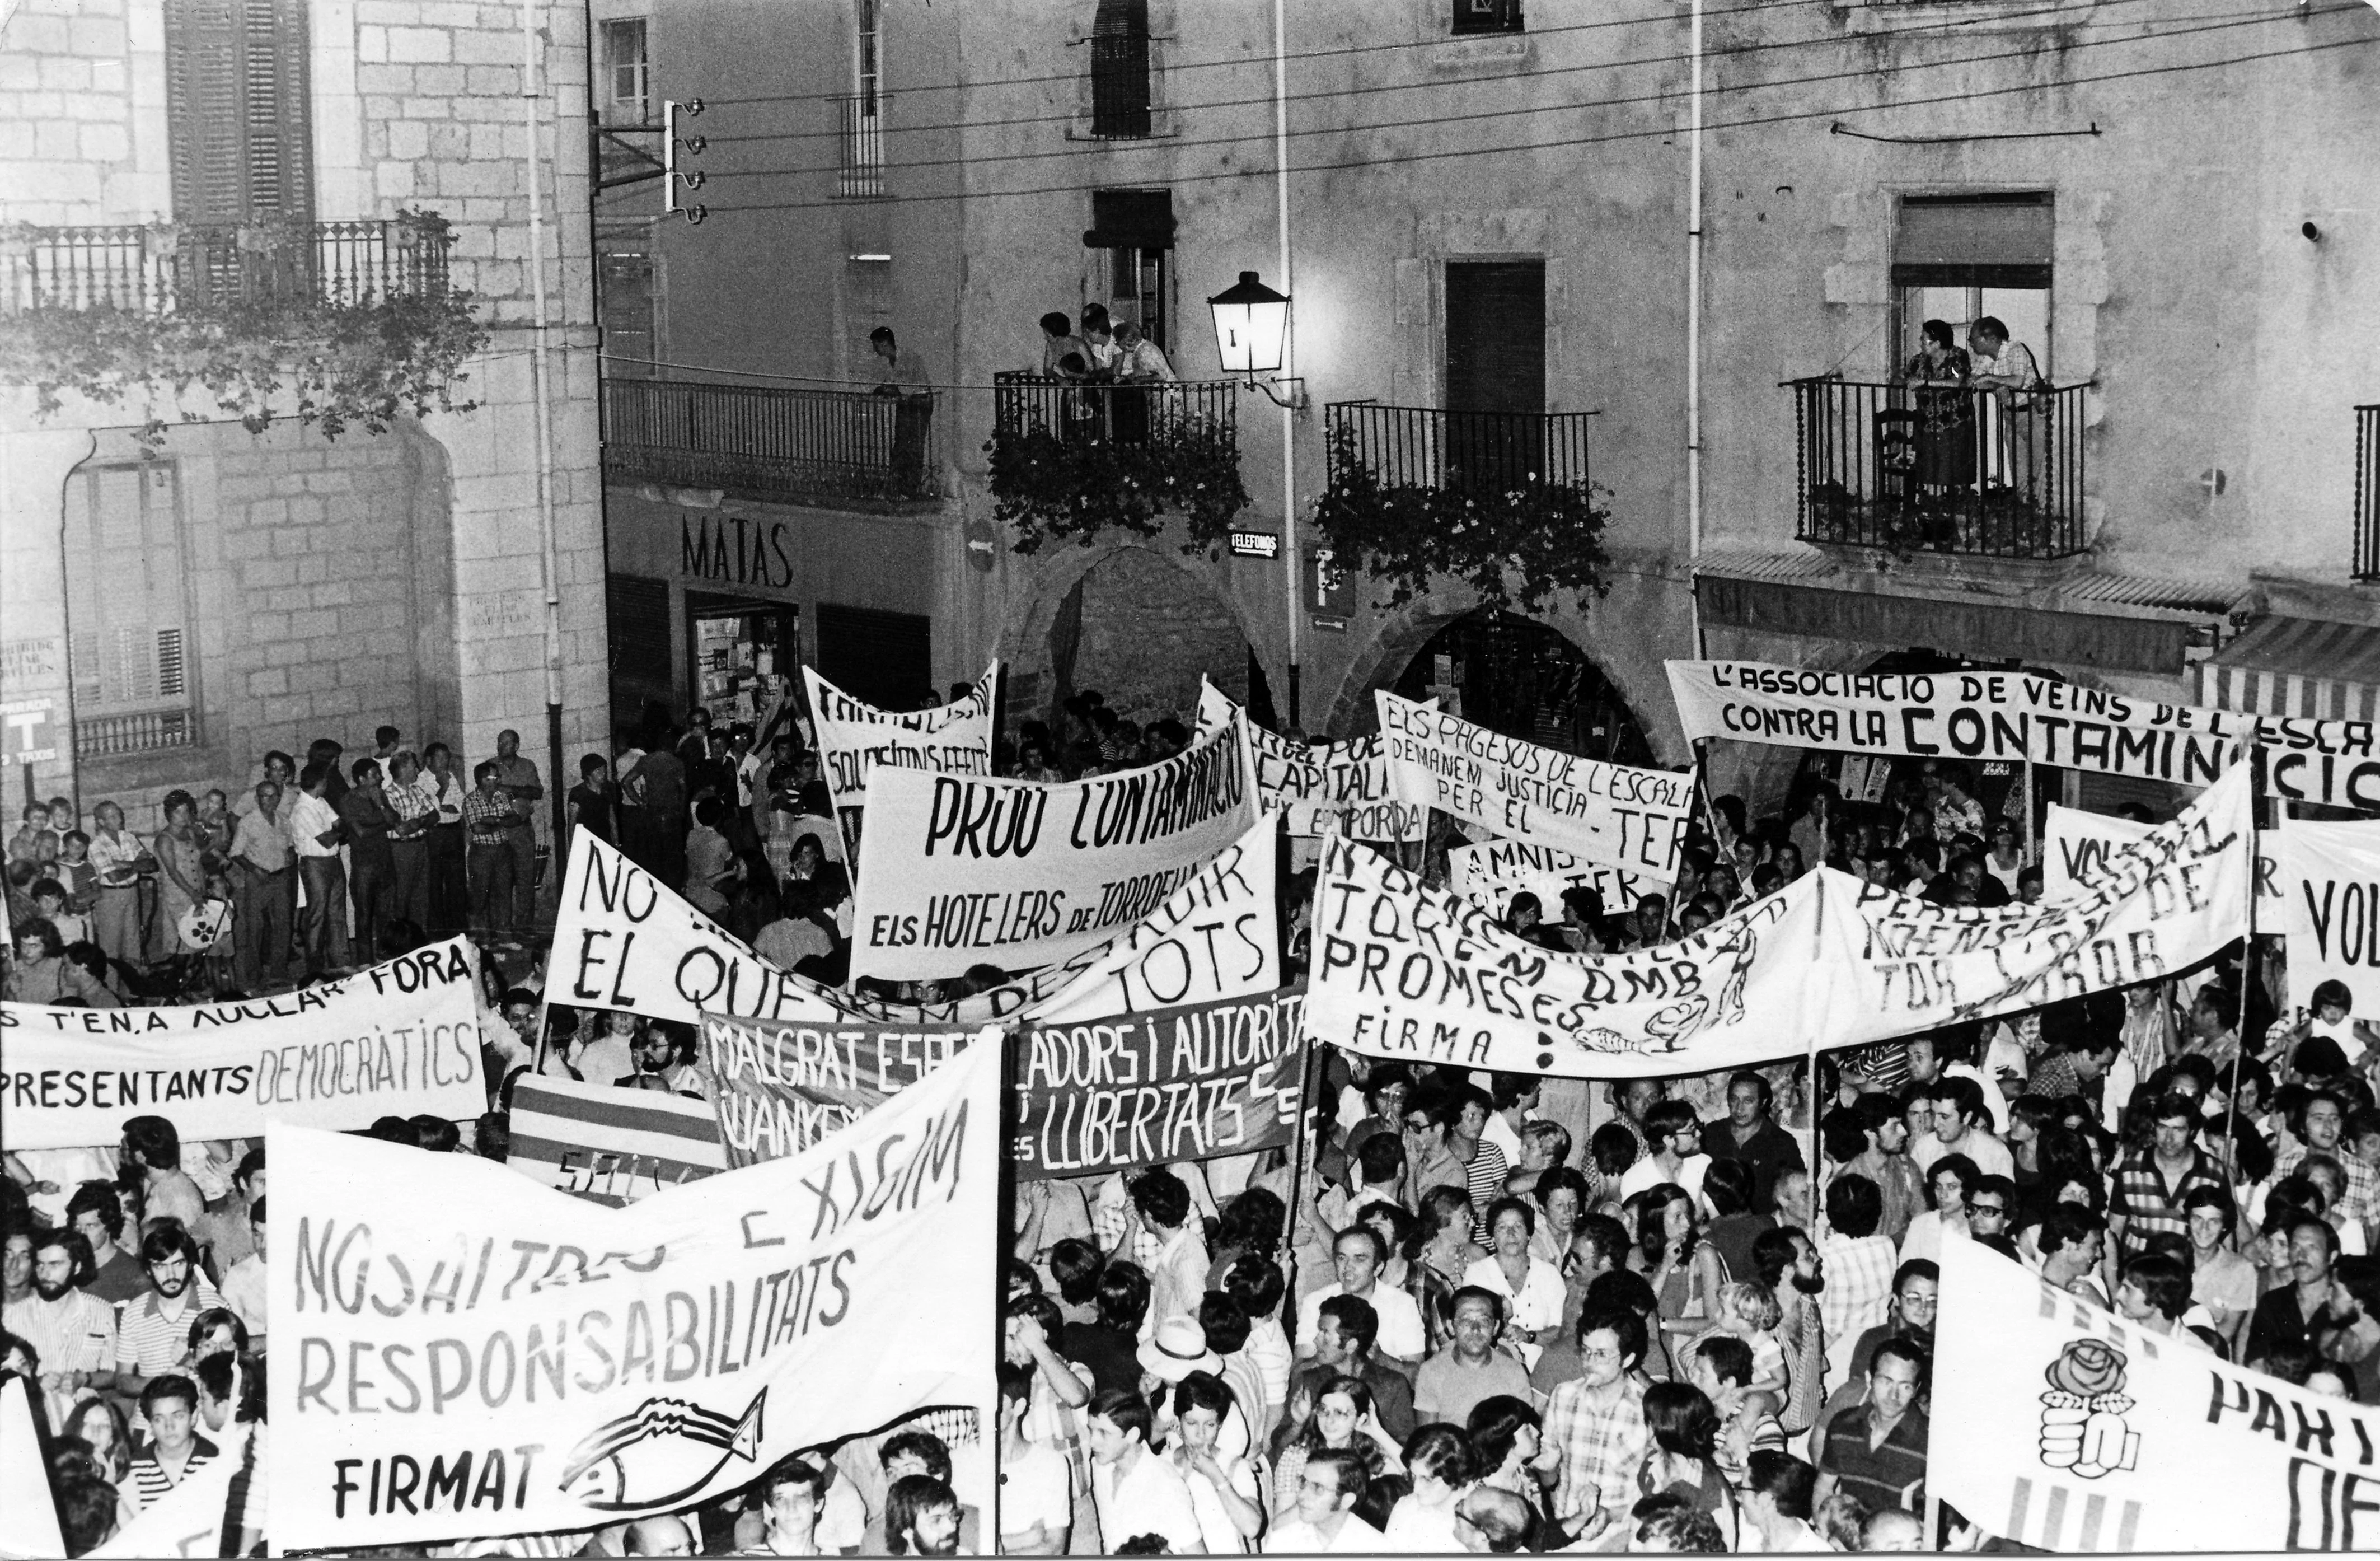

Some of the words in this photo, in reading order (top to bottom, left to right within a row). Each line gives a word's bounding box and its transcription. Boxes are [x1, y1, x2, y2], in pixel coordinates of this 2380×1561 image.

[682, 513, 793, 588] MATAS
[7, 711, 45, 750] T
[1713, 664, 1934, 703] L'ASSOCIACIO
[1961, 676, 2006, 702] DE
[2023, 677, 2131, 722] VEINS
[2151, 703, 2193, 728] DE
[1723, 703, 1838, 742] CONTRA
[1850, 709, 1887, 748] LA
[1386, 697, 1431, 739] ELS
[1437, 715, 1540, 774] PAGESOS
[1547, 754, 1582, 786] DE
[1393, 737, 1482, 786] DEMANEM
[925, 777, 1048, 859] PROU
[1437, 779, 1483, 816] PER
[1504, 798, 1532, 834] EL
[579, 840, 658, 923] NO
[870, 915, 917, 947] ELS
[924, 890, 1066, 948] HOTELERS
[1066, 907, 1095, 934] DE
[369, 944, 472, 996] FORA
[573, 927, 636, 1007] EL
[1108, 913, 1264, 1014] TOTS
[256, 1018, 474, 1106] DEMOCRÀTICS
[709, 1021, 865, 1092] MALGRAT
[1041, 1076, 1244, 1170] LLIBERTATS
[296, 1248, 856, 1415] RESPONSABILITATS
[332, 1442, 545, 1520] FIRMAT
